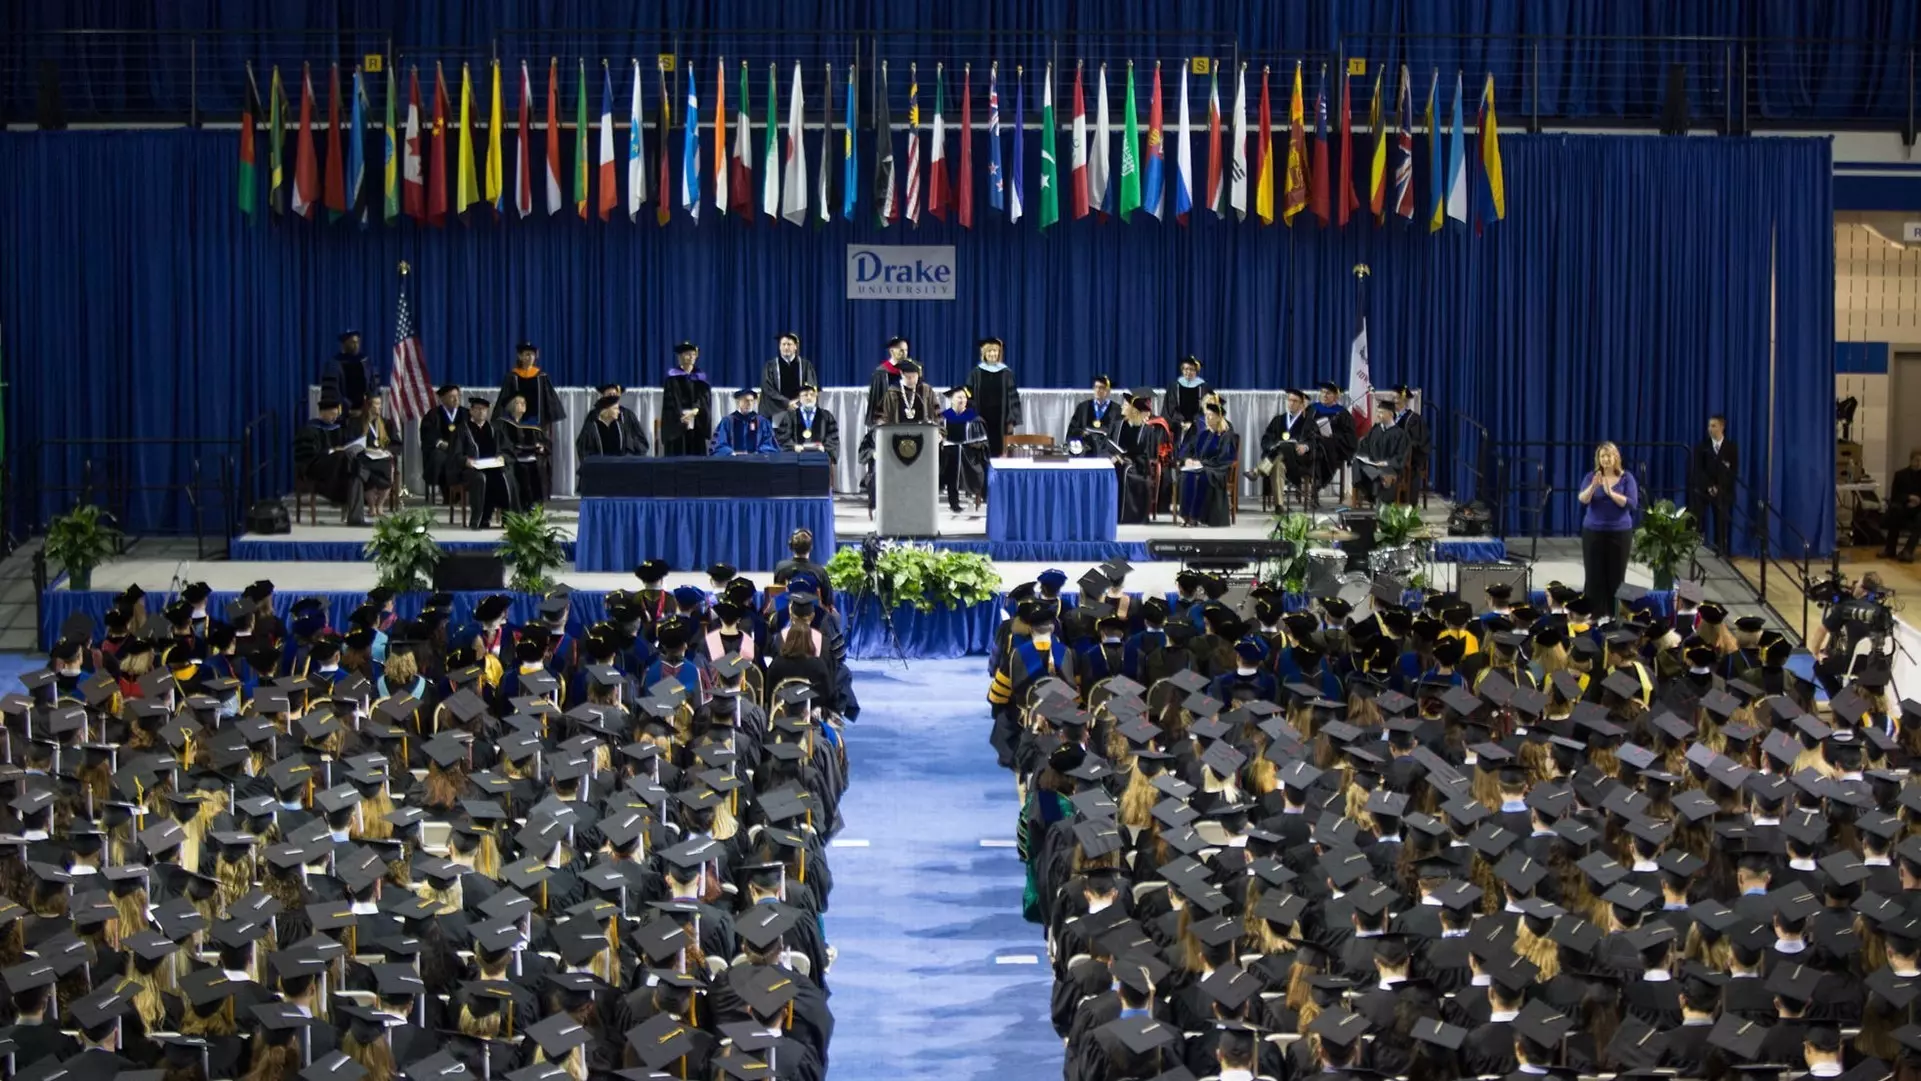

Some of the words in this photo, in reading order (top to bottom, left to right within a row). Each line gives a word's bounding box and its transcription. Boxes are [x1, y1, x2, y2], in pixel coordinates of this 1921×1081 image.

[369, 58, 379, 69] R
[662, 57, 671, 69] S
[1196, 60, 1206, 71] S
[1353, 61, 1363, 72] T
[852, 251, 951, 283] Drake
[858, 285, 948, 295] UNIVERSITY
